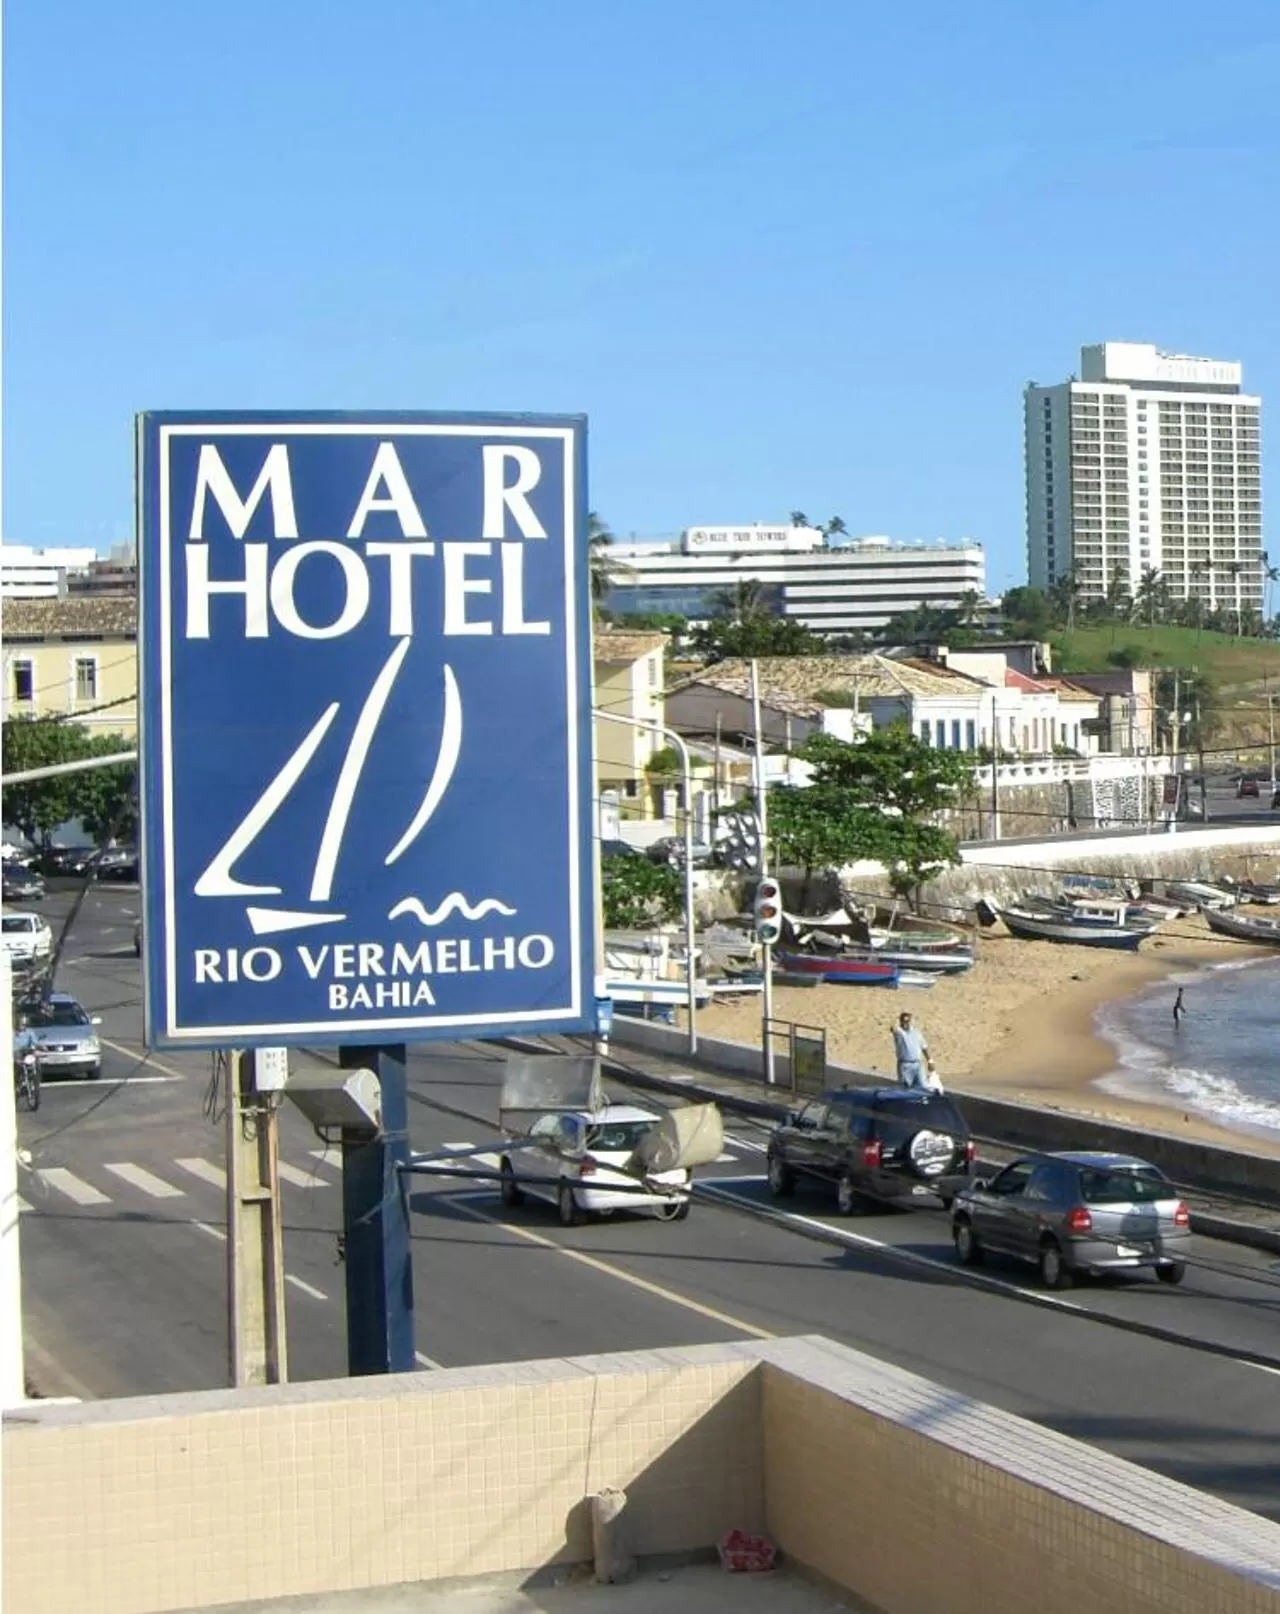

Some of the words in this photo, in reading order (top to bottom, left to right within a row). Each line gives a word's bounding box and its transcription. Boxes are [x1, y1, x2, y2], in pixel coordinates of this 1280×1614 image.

[189, 441, 548, 540] MAR
[185, 540, 552, 639] HOTEL
[194, 946, 282, 984] RIO
[297, 934, 556, 979] VERMELHO
[328, 979, 436, 1010] BAHIA
